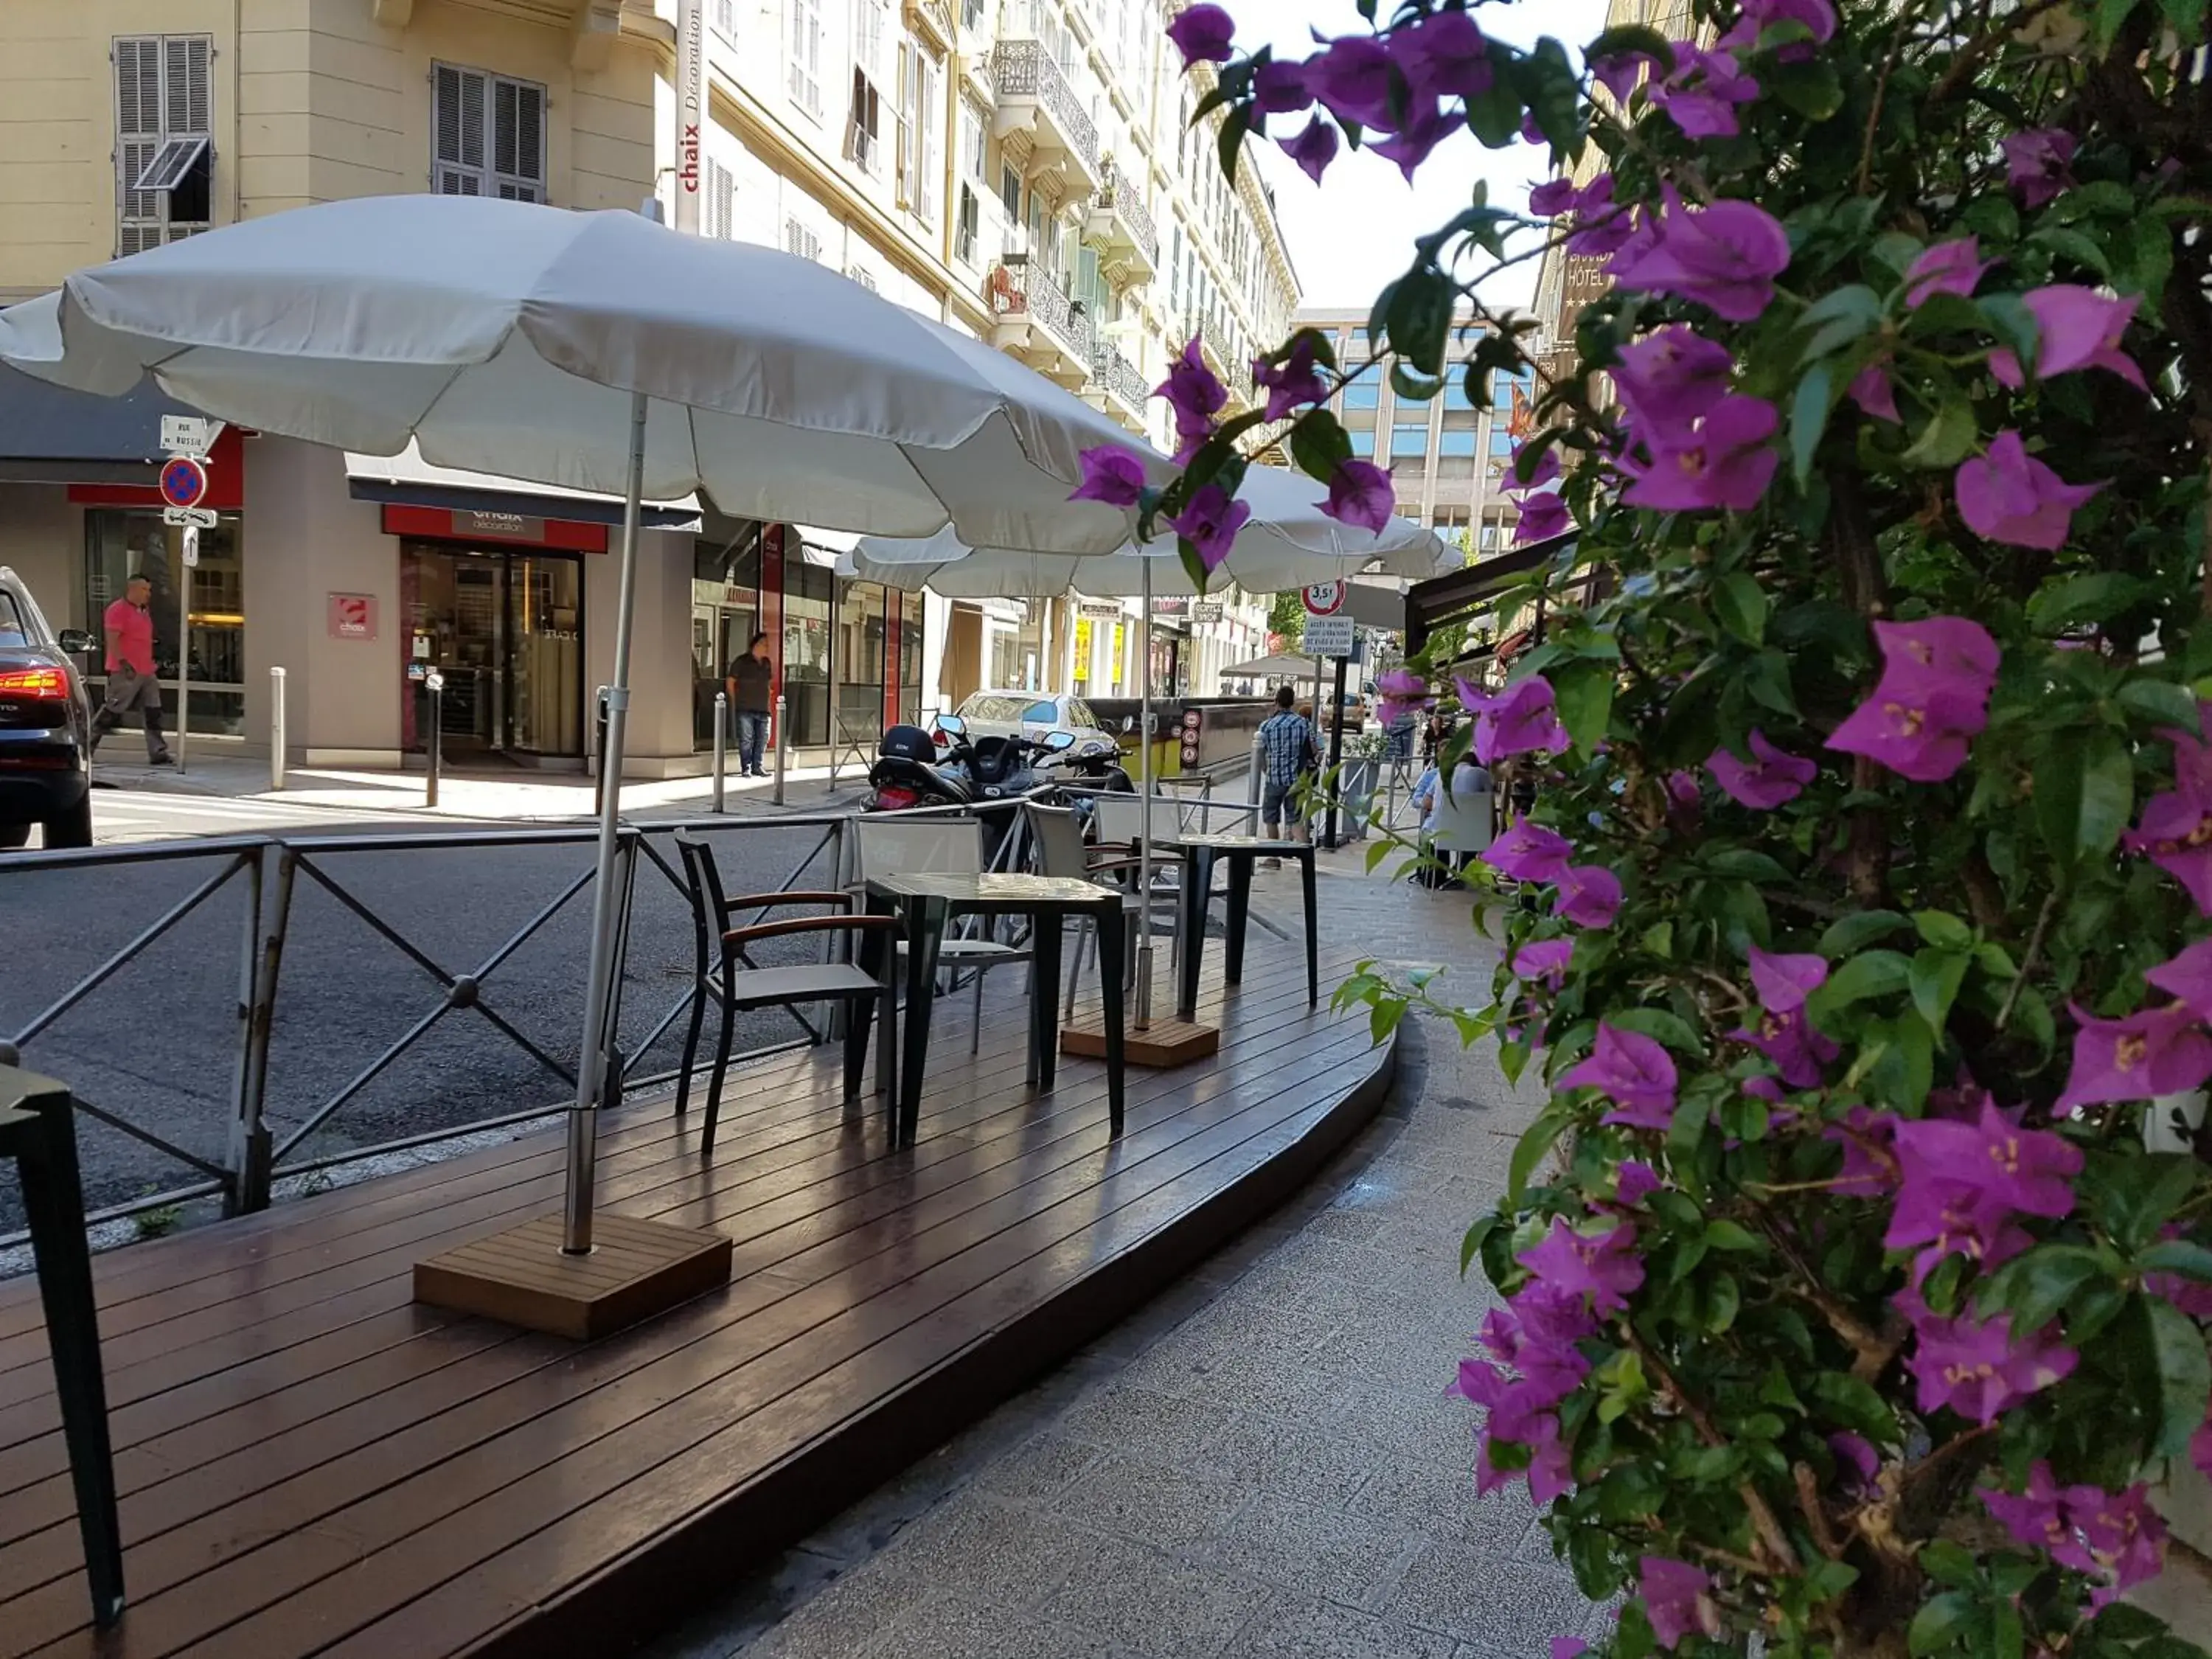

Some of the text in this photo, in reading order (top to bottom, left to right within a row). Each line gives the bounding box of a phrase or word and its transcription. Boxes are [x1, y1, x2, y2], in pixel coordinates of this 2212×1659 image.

[679, 9, 700, 193] chaix Décoration
[1568, 266, 1604, 286] HÔTEL
